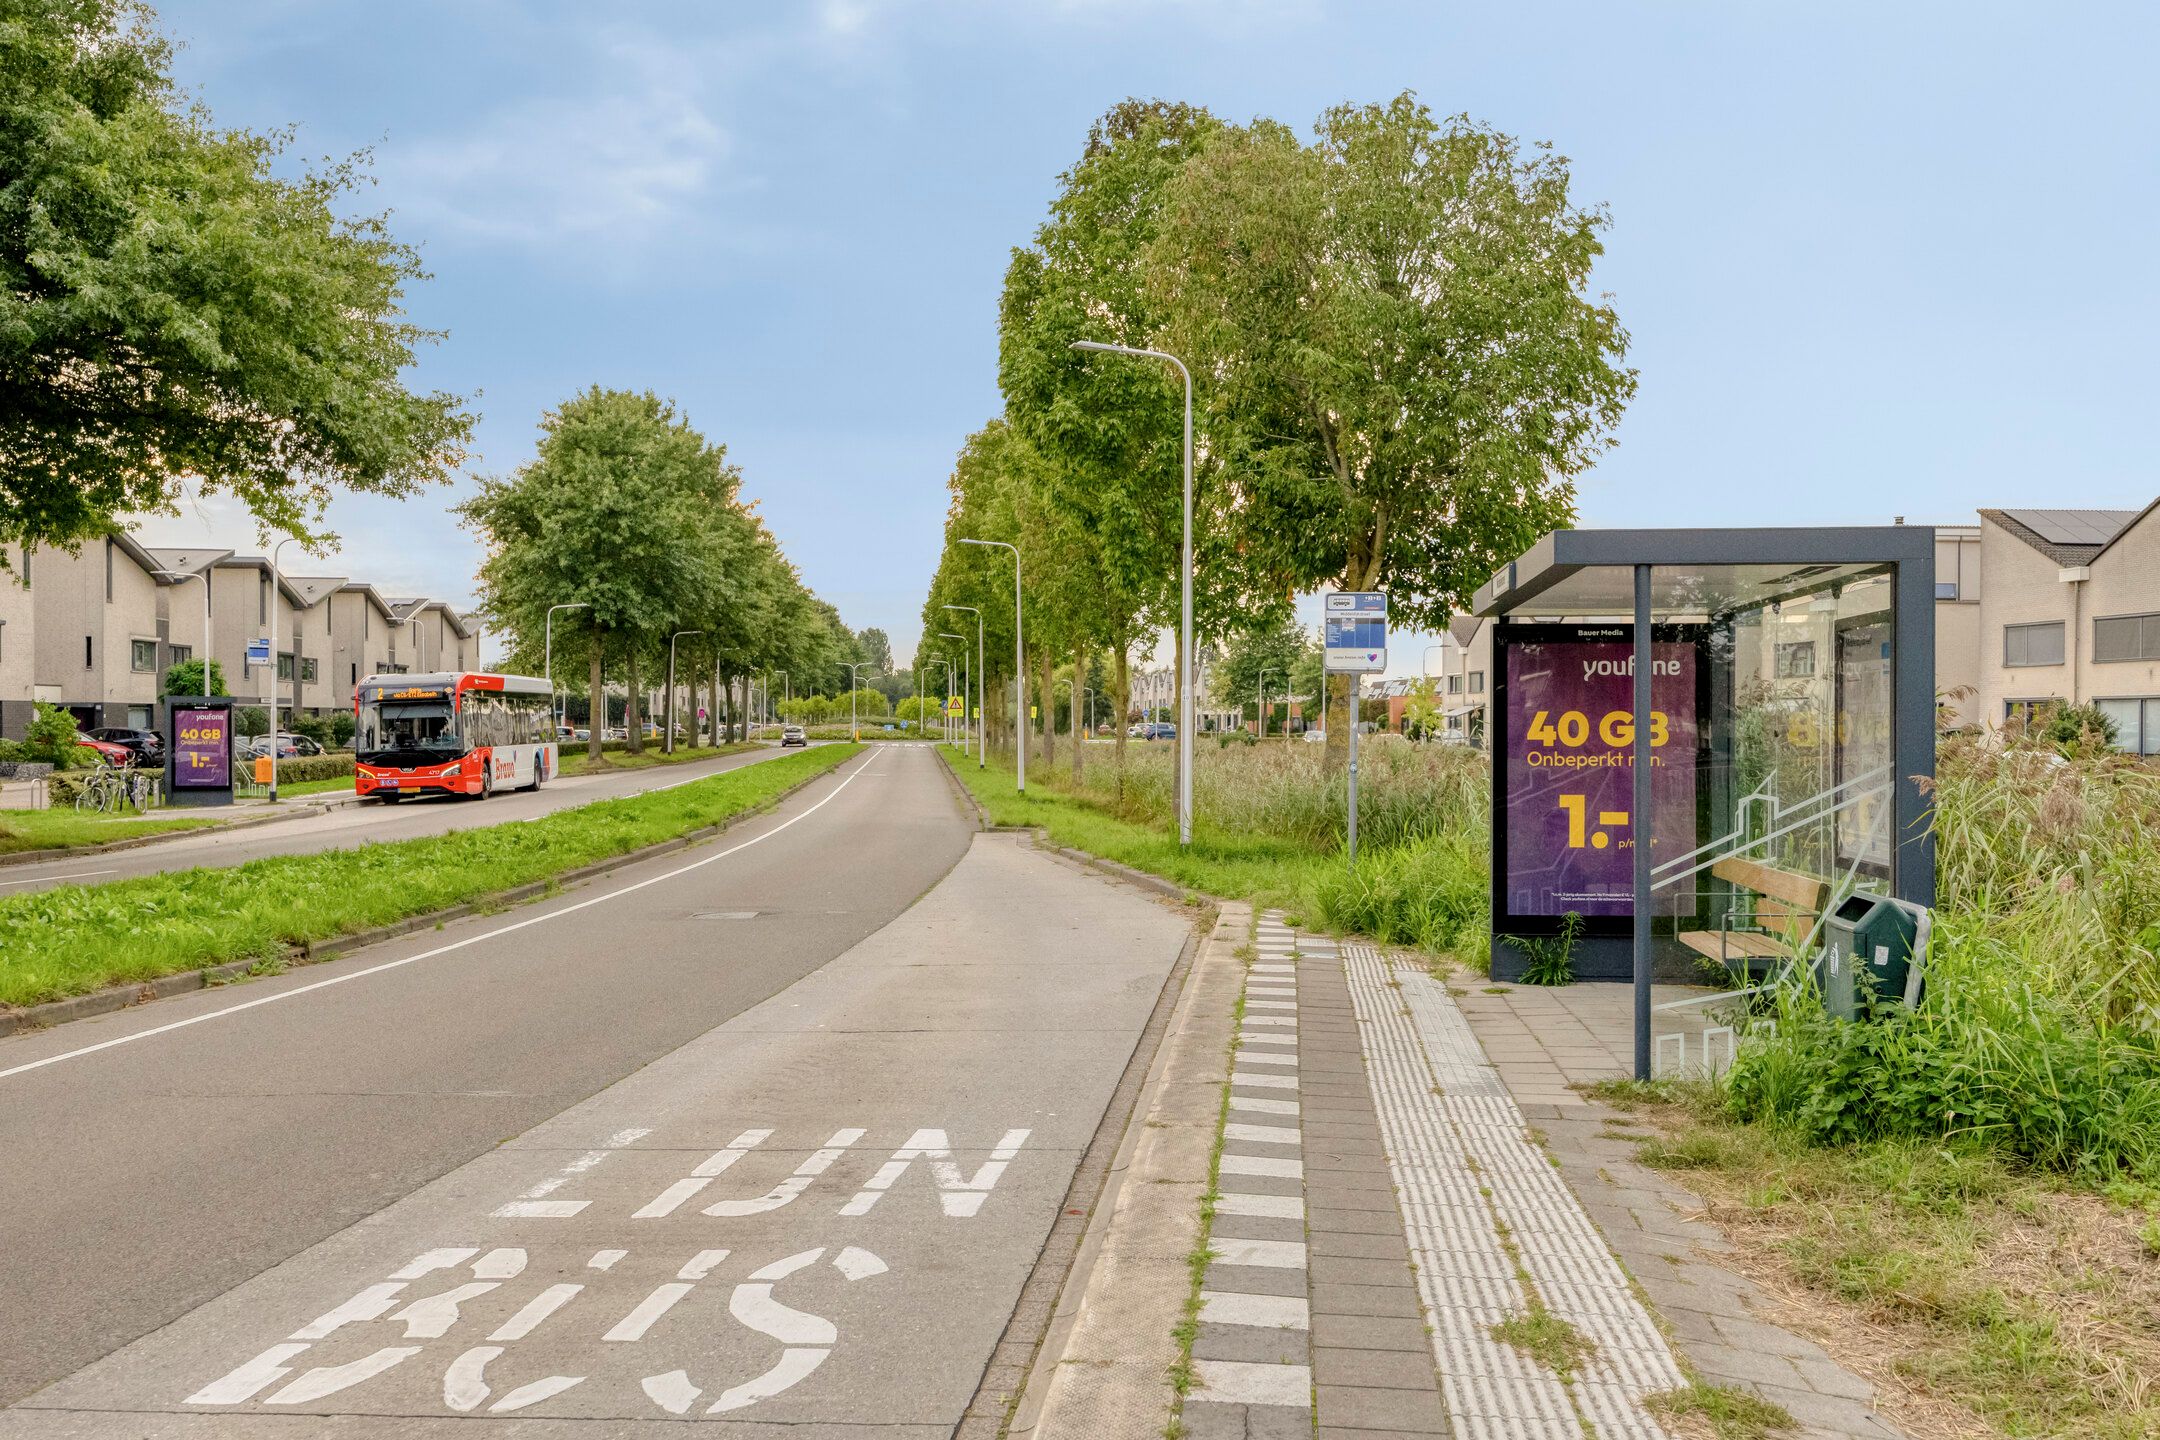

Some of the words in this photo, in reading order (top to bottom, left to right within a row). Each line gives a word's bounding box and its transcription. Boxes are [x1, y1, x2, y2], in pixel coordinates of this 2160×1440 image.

[1583, 655, 1681, 682] youfne
[377, 687, 384, 700] 2
[196, 713, 224, 722] youfone
[1527, 710, 1590, 747] 40
[180, 728, 199, 740] 40
[201, 728, 221, 740] GB
[495, 757, 515, 781] Bravo
[1527, 751, 1624, 770] Onbeperkt
[490, 1128, 1033, 1219] LIJN
[183, 1245, 888, 1415] BUS
